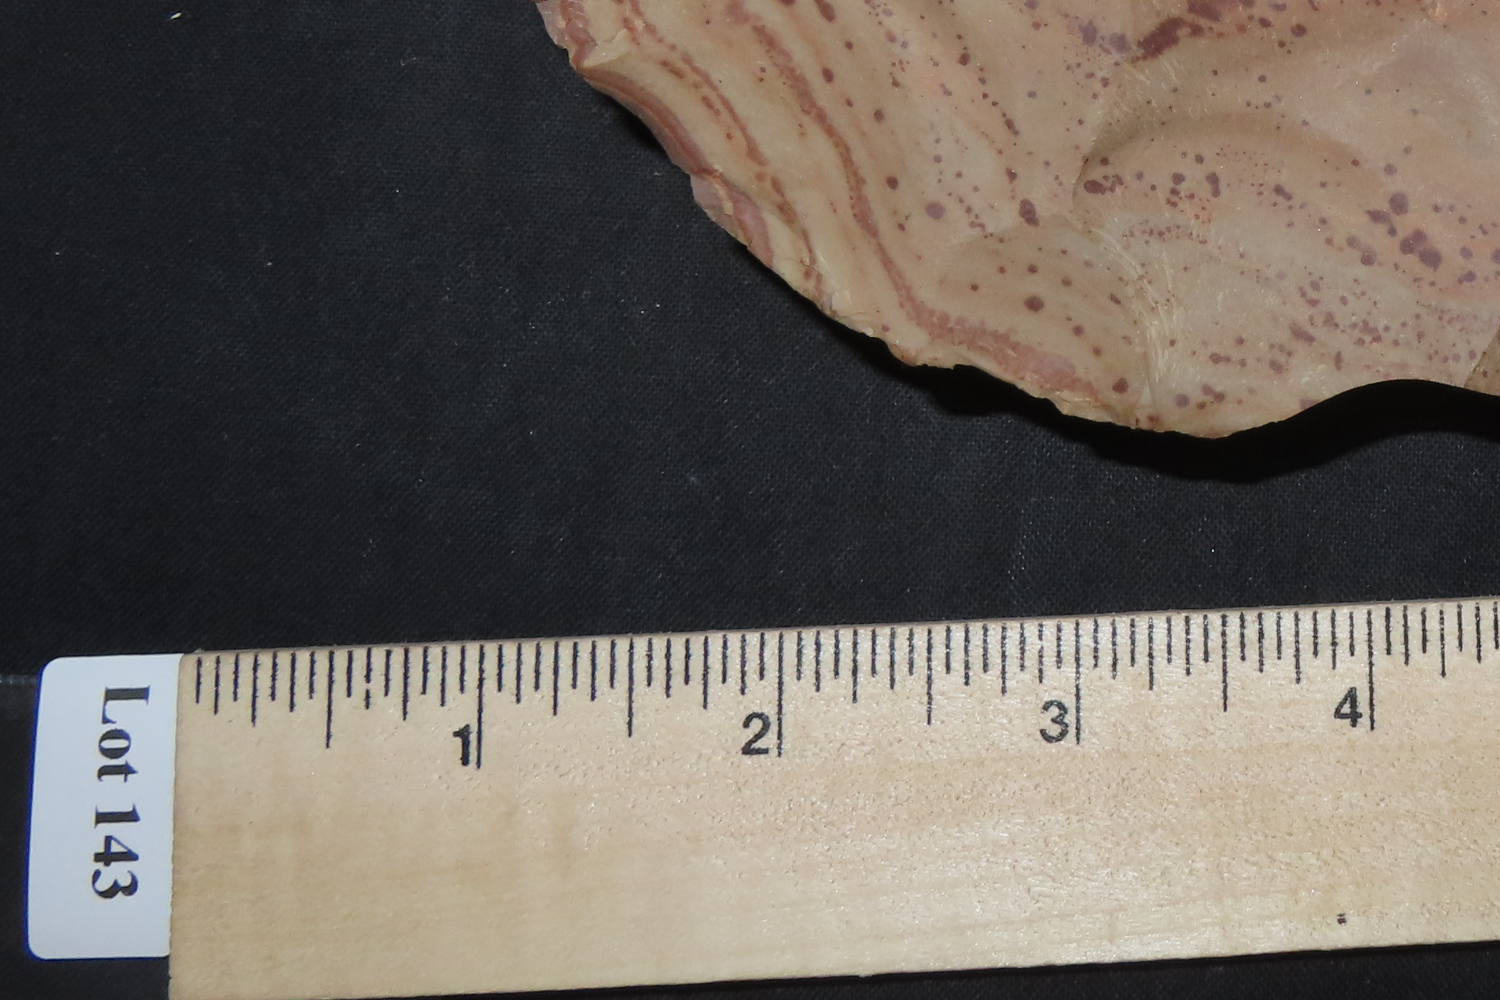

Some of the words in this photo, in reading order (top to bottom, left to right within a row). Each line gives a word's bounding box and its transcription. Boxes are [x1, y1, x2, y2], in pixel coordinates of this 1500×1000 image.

[97, 685, 149, 782] Lot
[453, 724, 472, 766] 1
[741, 712, 771, 756] 2
[1040, 700, 1069, 743] 3
[1334, 687, 1362, 728] 4
[92, 806, 140, 899] 143
